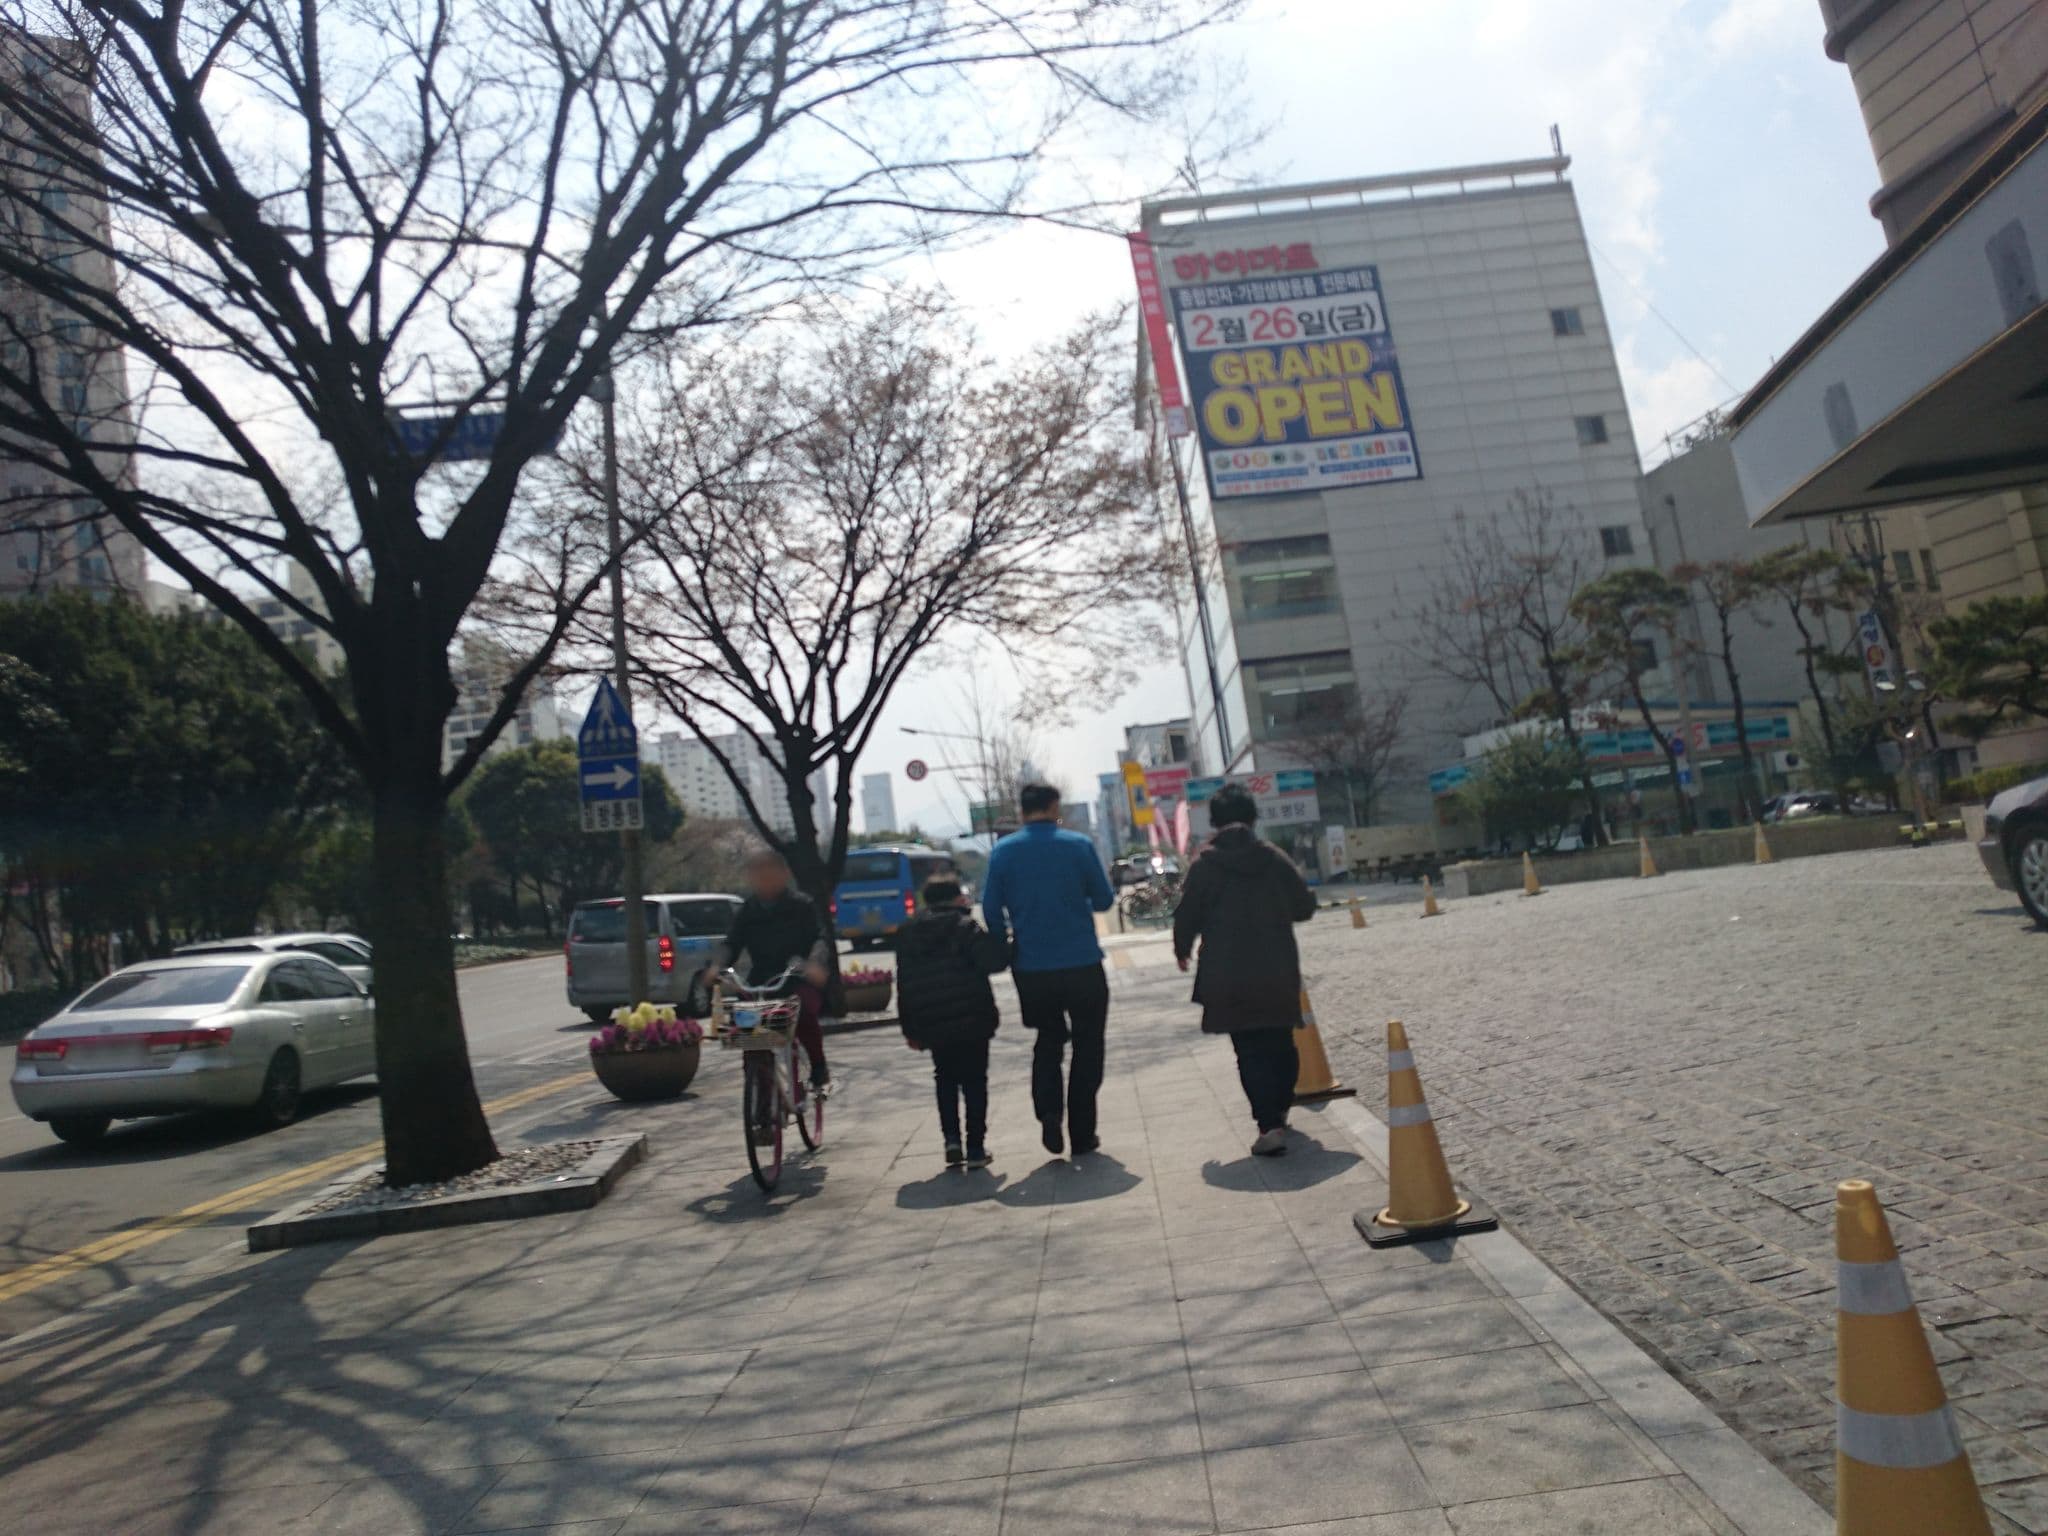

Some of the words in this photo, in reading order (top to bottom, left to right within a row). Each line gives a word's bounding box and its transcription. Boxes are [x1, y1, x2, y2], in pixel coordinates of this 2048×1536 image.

[1173, 242, 1319, 281] 하이마트
[1192, 314, 1247, 347] 2월
[1249, 303, 1376, 342] 26일(금)
[1211, 339, 1371, 386] GRAND
[1204, 371, 1404, 446] OPEN
